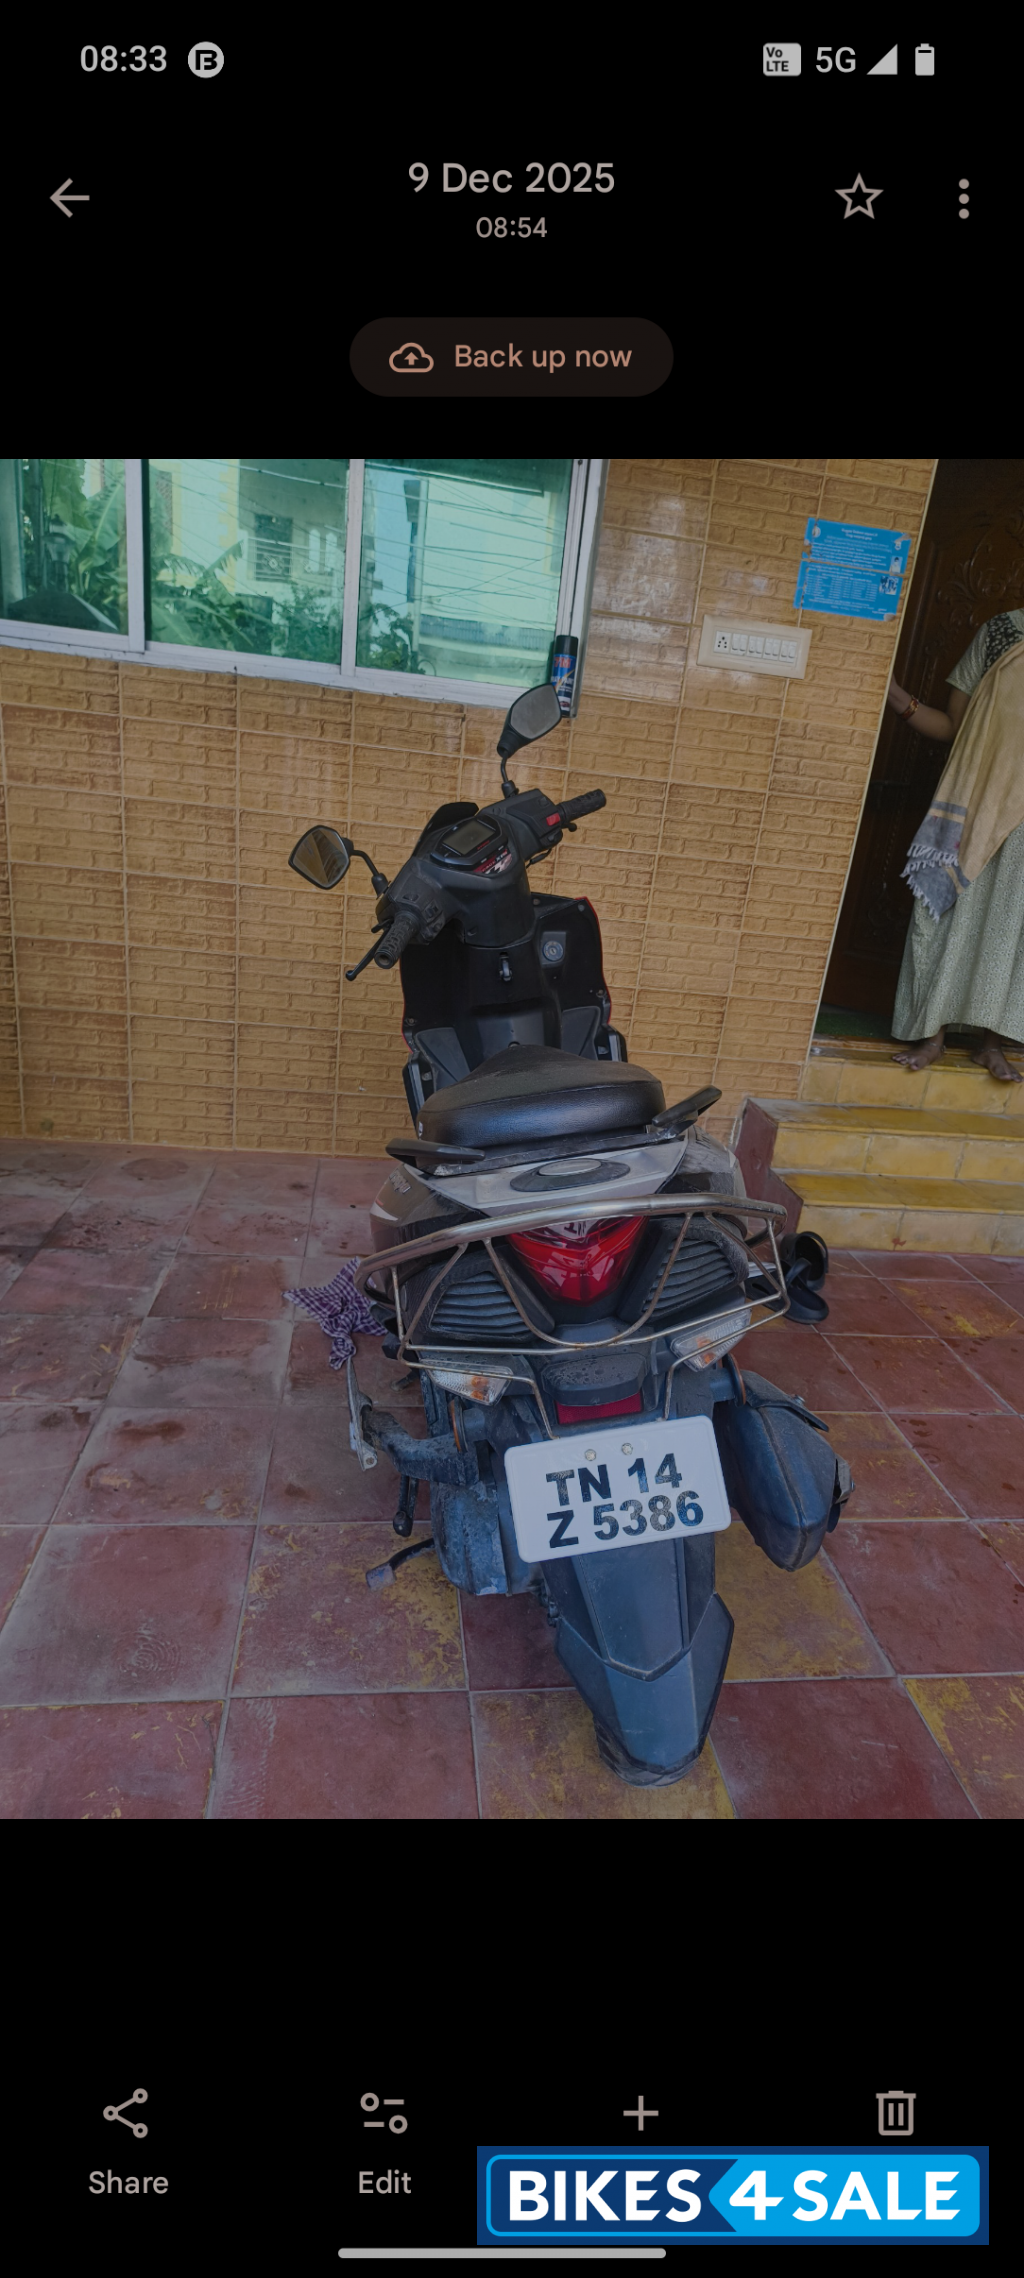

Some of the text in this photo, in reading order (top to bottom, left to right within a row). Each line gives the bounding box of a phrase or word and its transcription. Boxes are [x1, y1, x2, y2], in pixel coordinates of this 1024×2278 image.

[81, 45, 167, 72] 08:33
[766, 46, 783, 58] Vo
[816, 46, 856, 73] 5G
[766, 60, 789, 72] LTE
[408, 162, 615, 194] 9 Dec 2025
[476, 216, 548, 239] 08:54
[455, 342, 633, 374] Back up now
[546, 1453, 682, 1507] TN 14
[546, 1490, 704, 1549] Z 5386
[88, 2169, 169, 2195] Share
[358, 2169, 412, 2195] Edit
